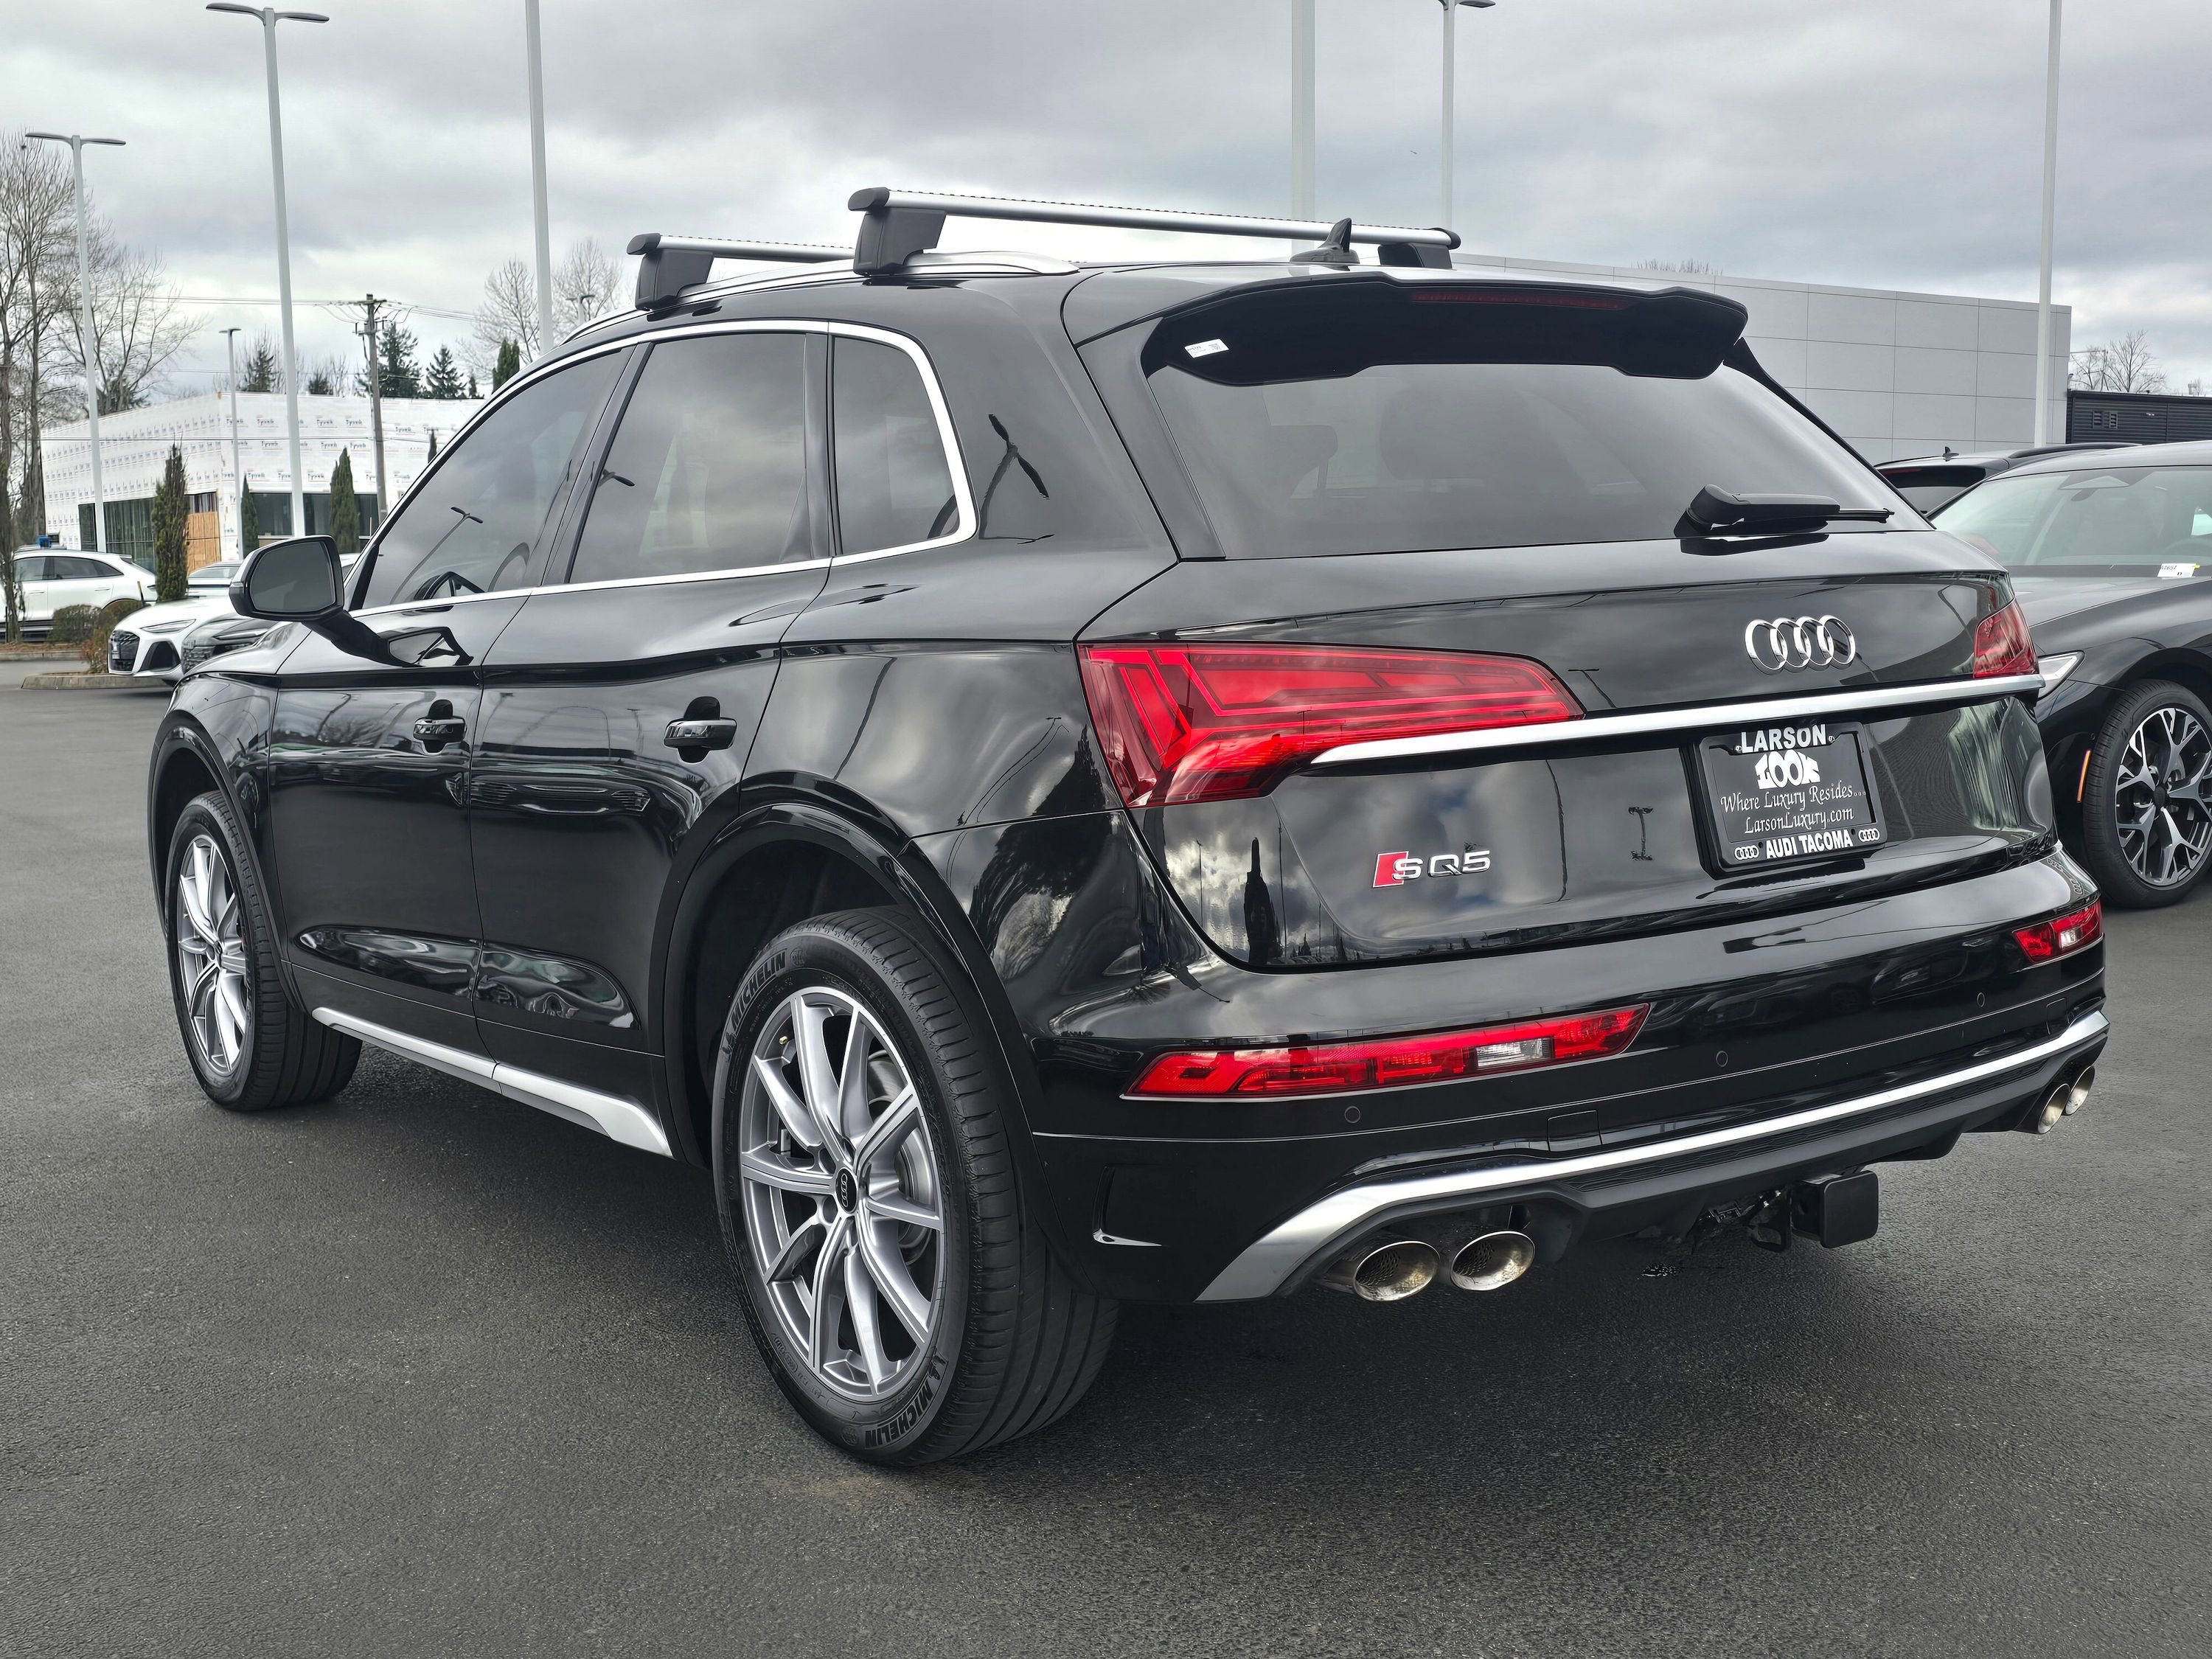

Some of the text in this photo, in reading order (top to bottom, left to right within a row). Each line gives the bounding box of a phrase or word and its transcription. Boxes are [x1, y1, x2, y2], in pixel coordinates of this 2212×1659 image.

[1741, 724, 1826, 754] LARSON
[1720, 791, 1760, 813] Where
[1764, 790, 1806, 811] Luxury
[1745, 807, 1854, 834] LarsonLuxury.com
[1766, 829, 1854, 859] AUDI TACOMA
[1392, 850, 1491, 880] SQ5
[731, 950, 786, 1032] MICHELIN
[865, 1382, 933, 1447] MICHELIN
